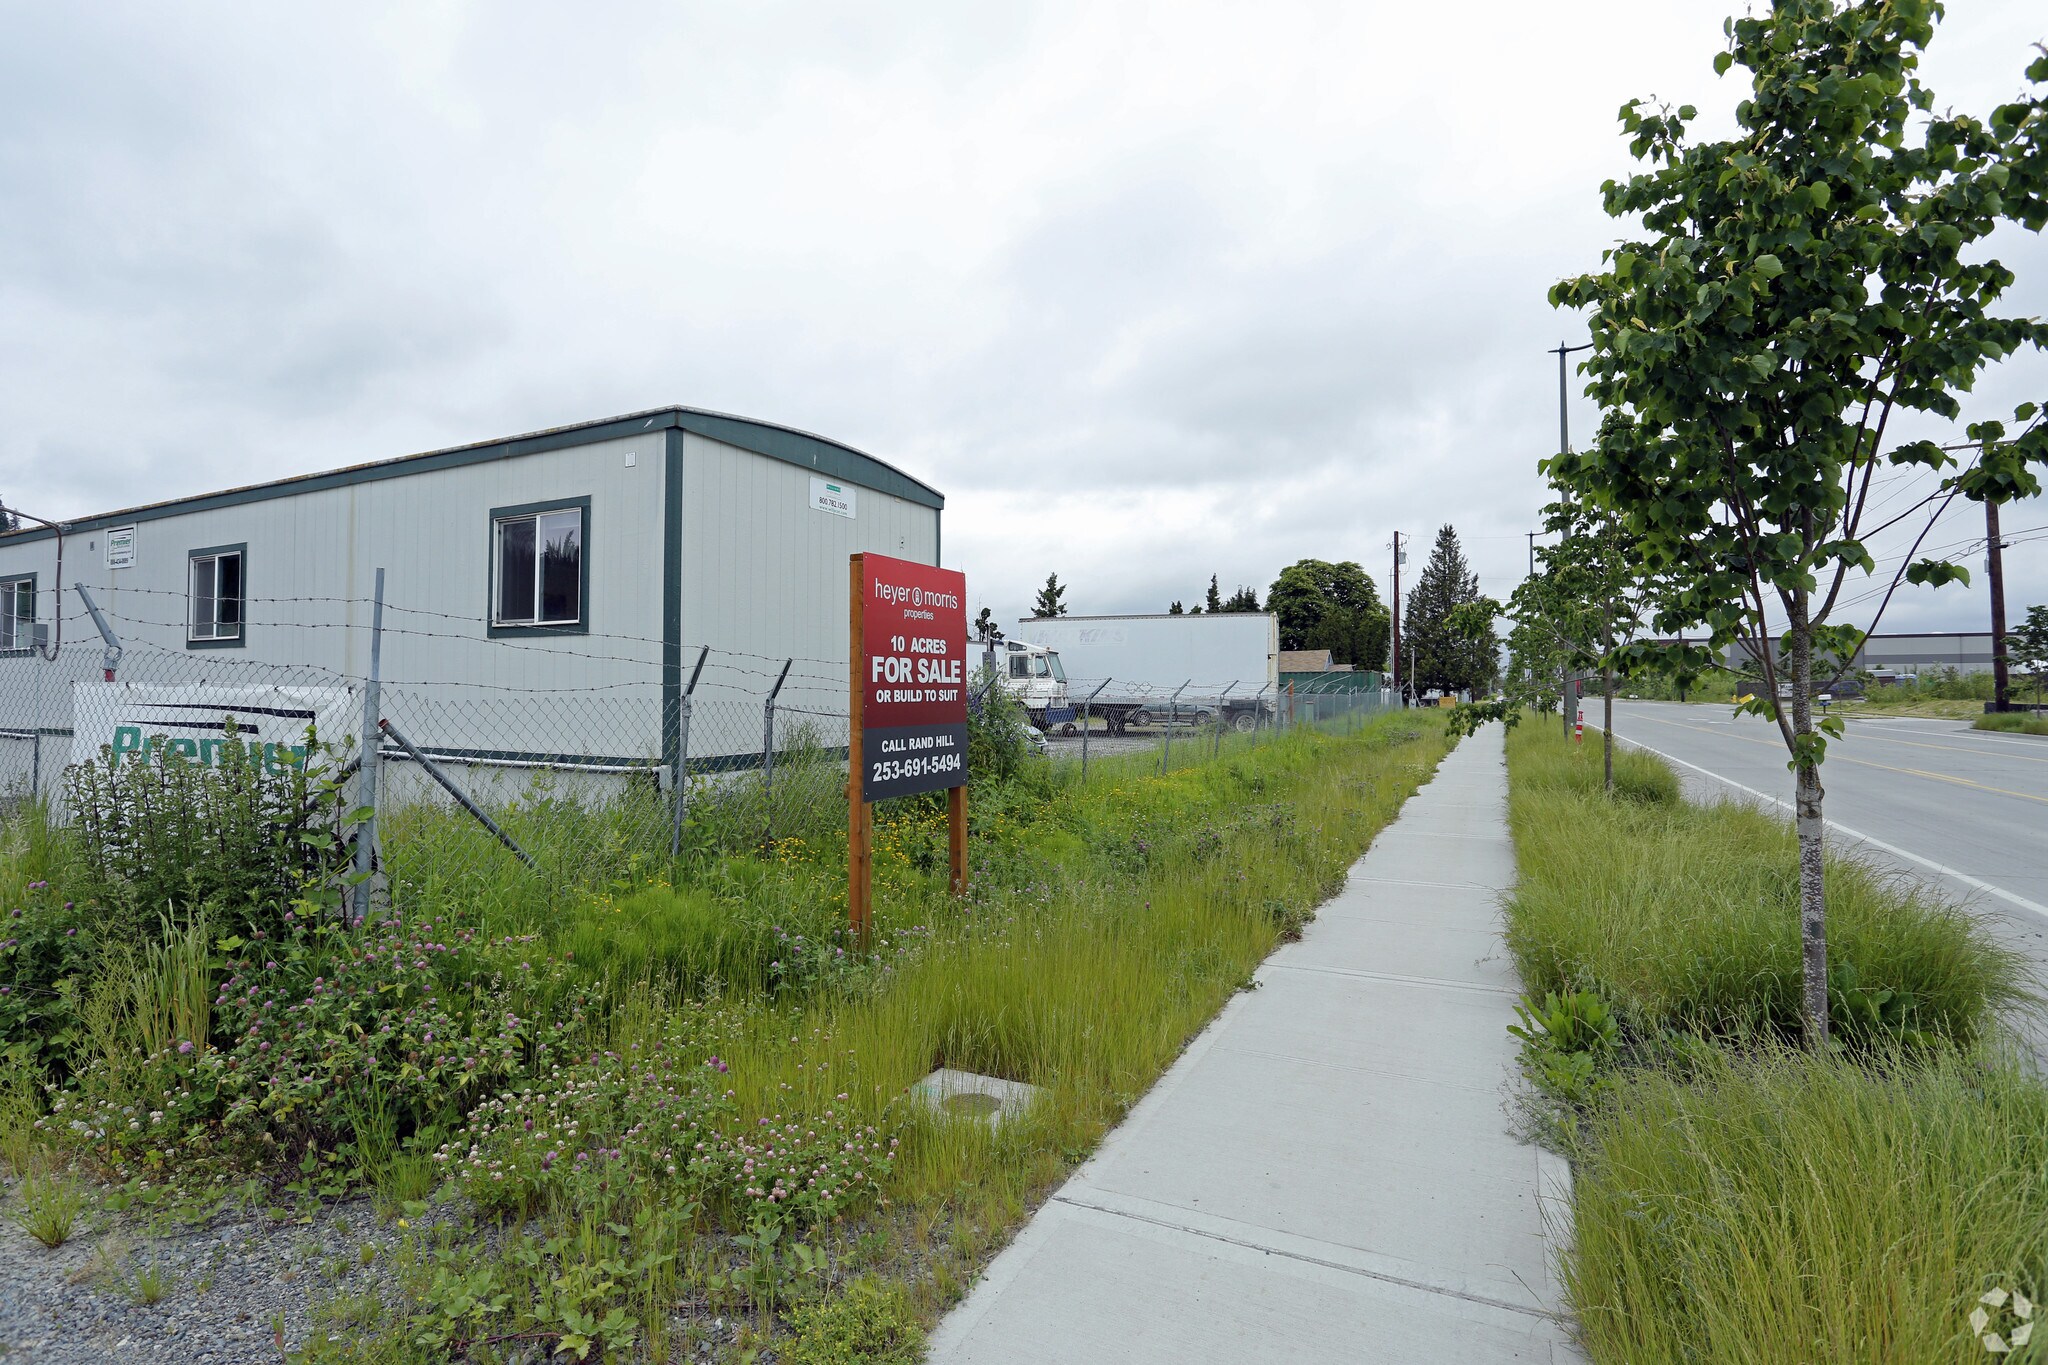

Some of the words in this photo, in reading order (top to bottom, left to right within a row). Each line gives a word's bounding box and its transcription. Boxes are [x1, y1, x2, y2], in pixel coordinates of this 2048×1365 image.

[819, 496, 848, 511] 800.782.1500
[875, 577, 911, 606] heyer
[924, 590, 958, 610] morris
[903, 608, 934, 620] properties
[890, 635, 905, 652] 10
[910, 637, 947, 655] ACRES
[872, 655, 913, 683] FOR
[917, 657, 961, 684] SALE
[876, 689, 892, 703] OR
[893, 689, 922, 703] BUILD
[924, 689, 937, 702] TO
[938, 689, 958, 702] SUIT
[881, 738, 907, 753] CALL
[908, 736, 934, 750] RAND
[935, 734, 955, 748] HILL
[872, 752, 961, 782] 253-691-5494
